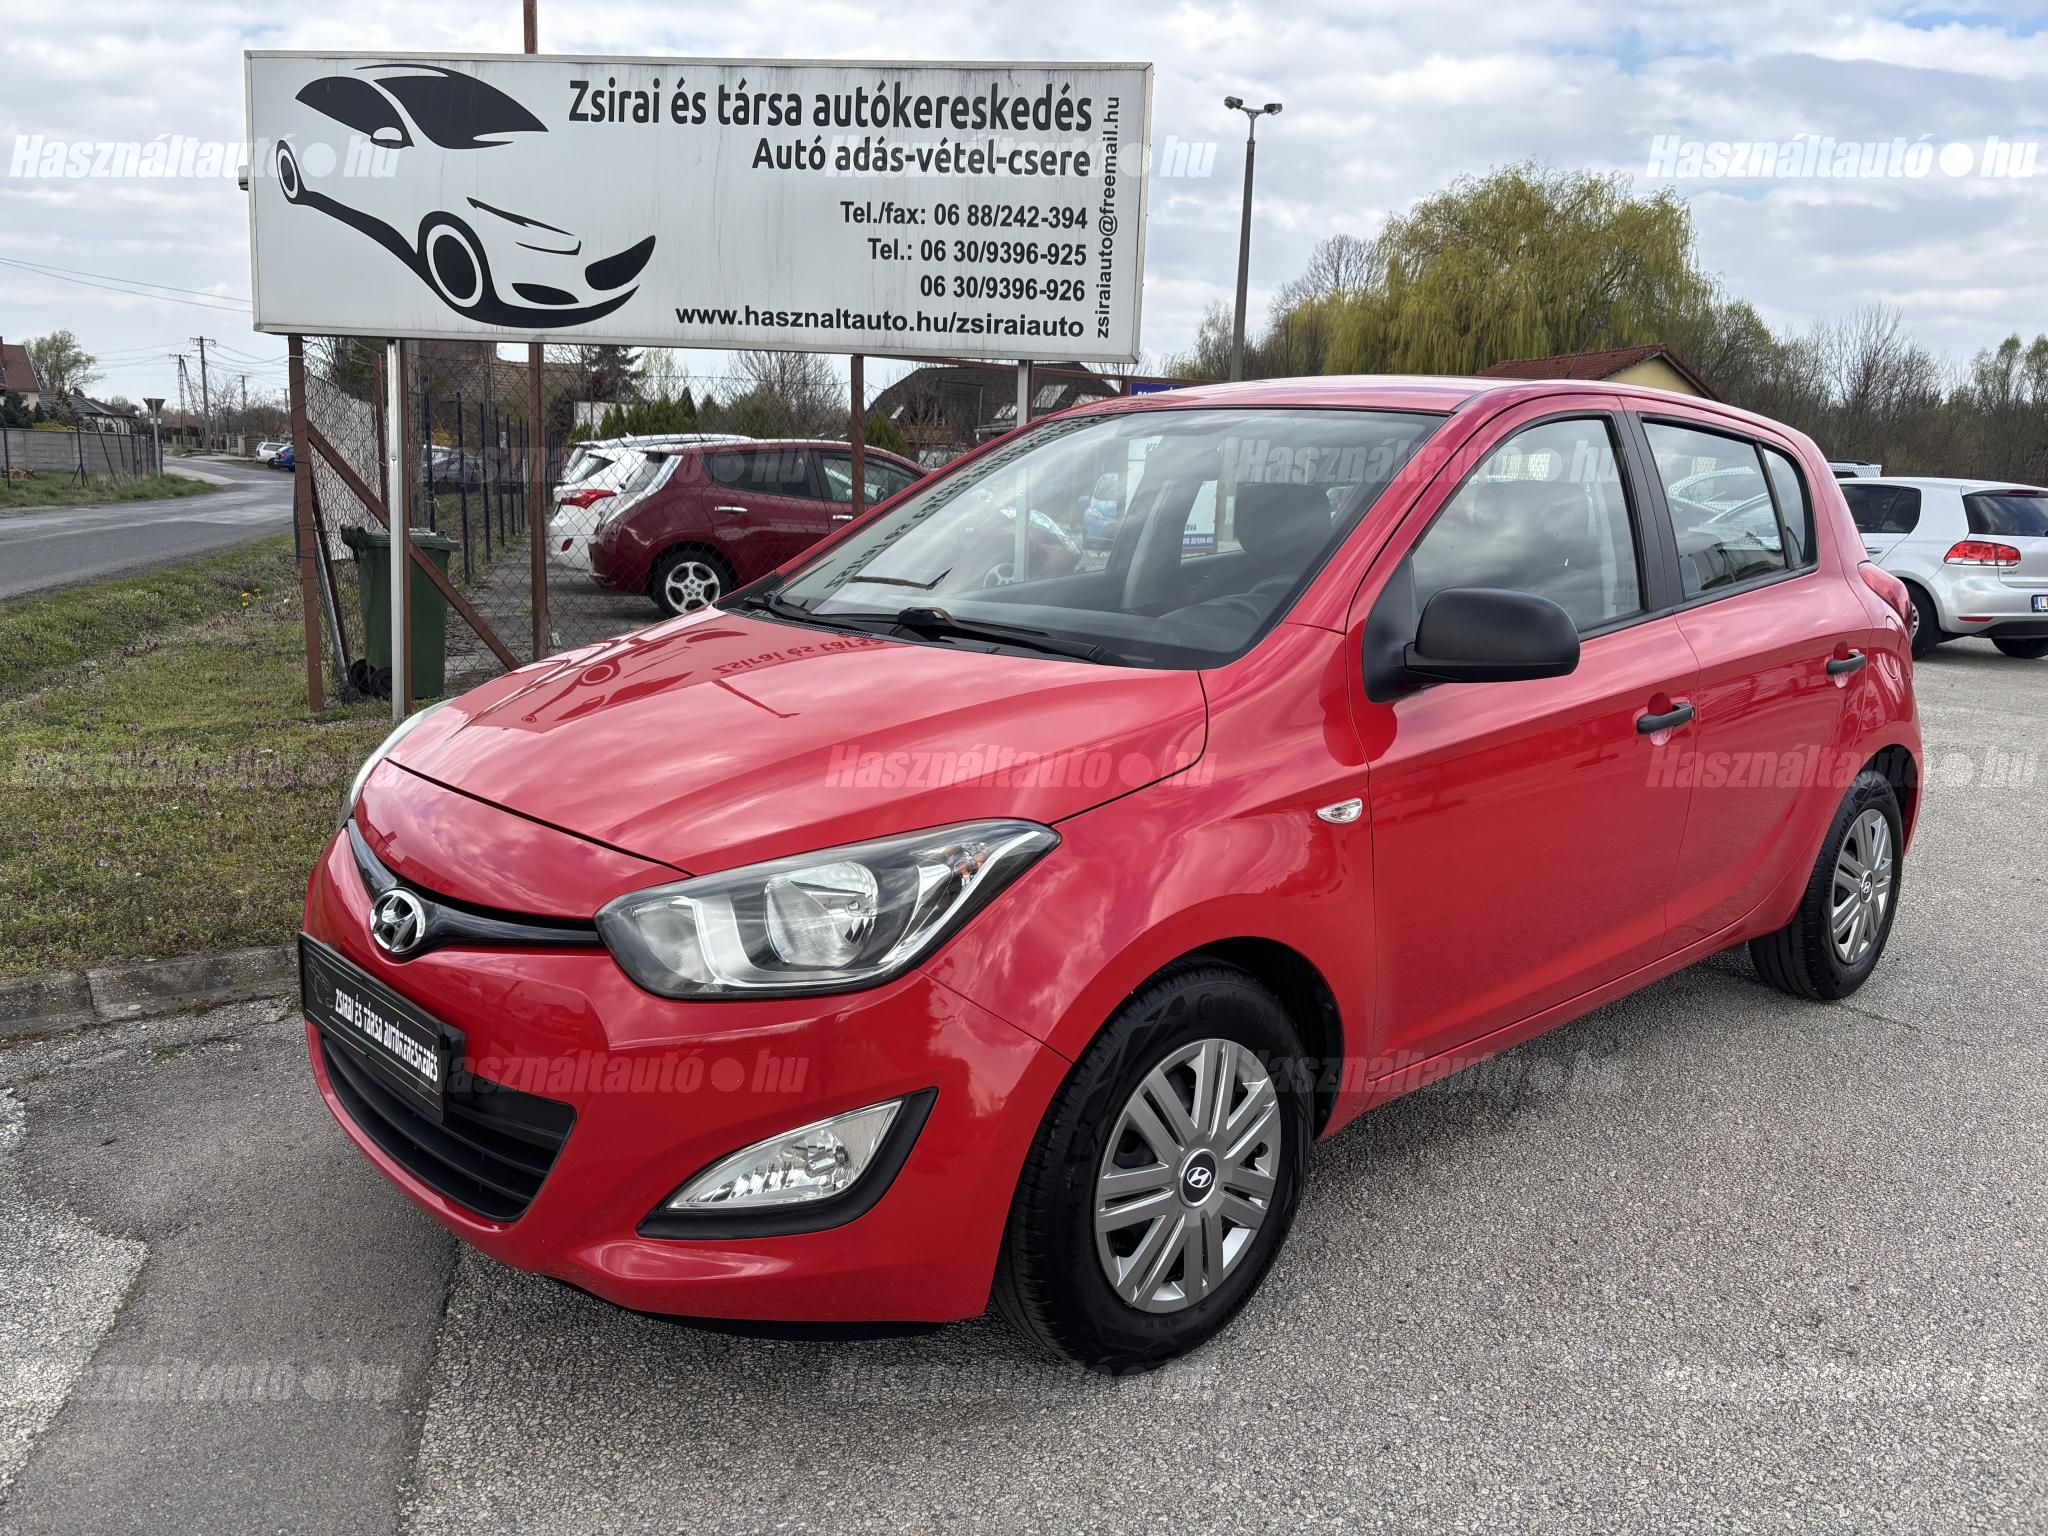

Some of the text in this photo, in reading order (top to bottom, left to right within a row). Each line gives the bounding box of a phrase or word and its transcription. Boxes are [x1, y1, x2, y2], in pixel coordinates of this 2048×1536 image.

[568, 76, 1092, 132] Zsirai és társa autókereskedés
[751, 134, 1091, 177] Autó adás-vétel-csere
[839, 200, 1088, 230] Tel./fax: 06 88/242-394
[1094, 97, 1121, 339] zsiraiauto@freemail.hu
[867, 237, 1087, 266] Tel.: 06 30/9396-925
[920, 274, 1085, 302] 06 30/9396-926
[675, 305, 1084, 338] www.hasznaltauto.hu/zsiraiauto
